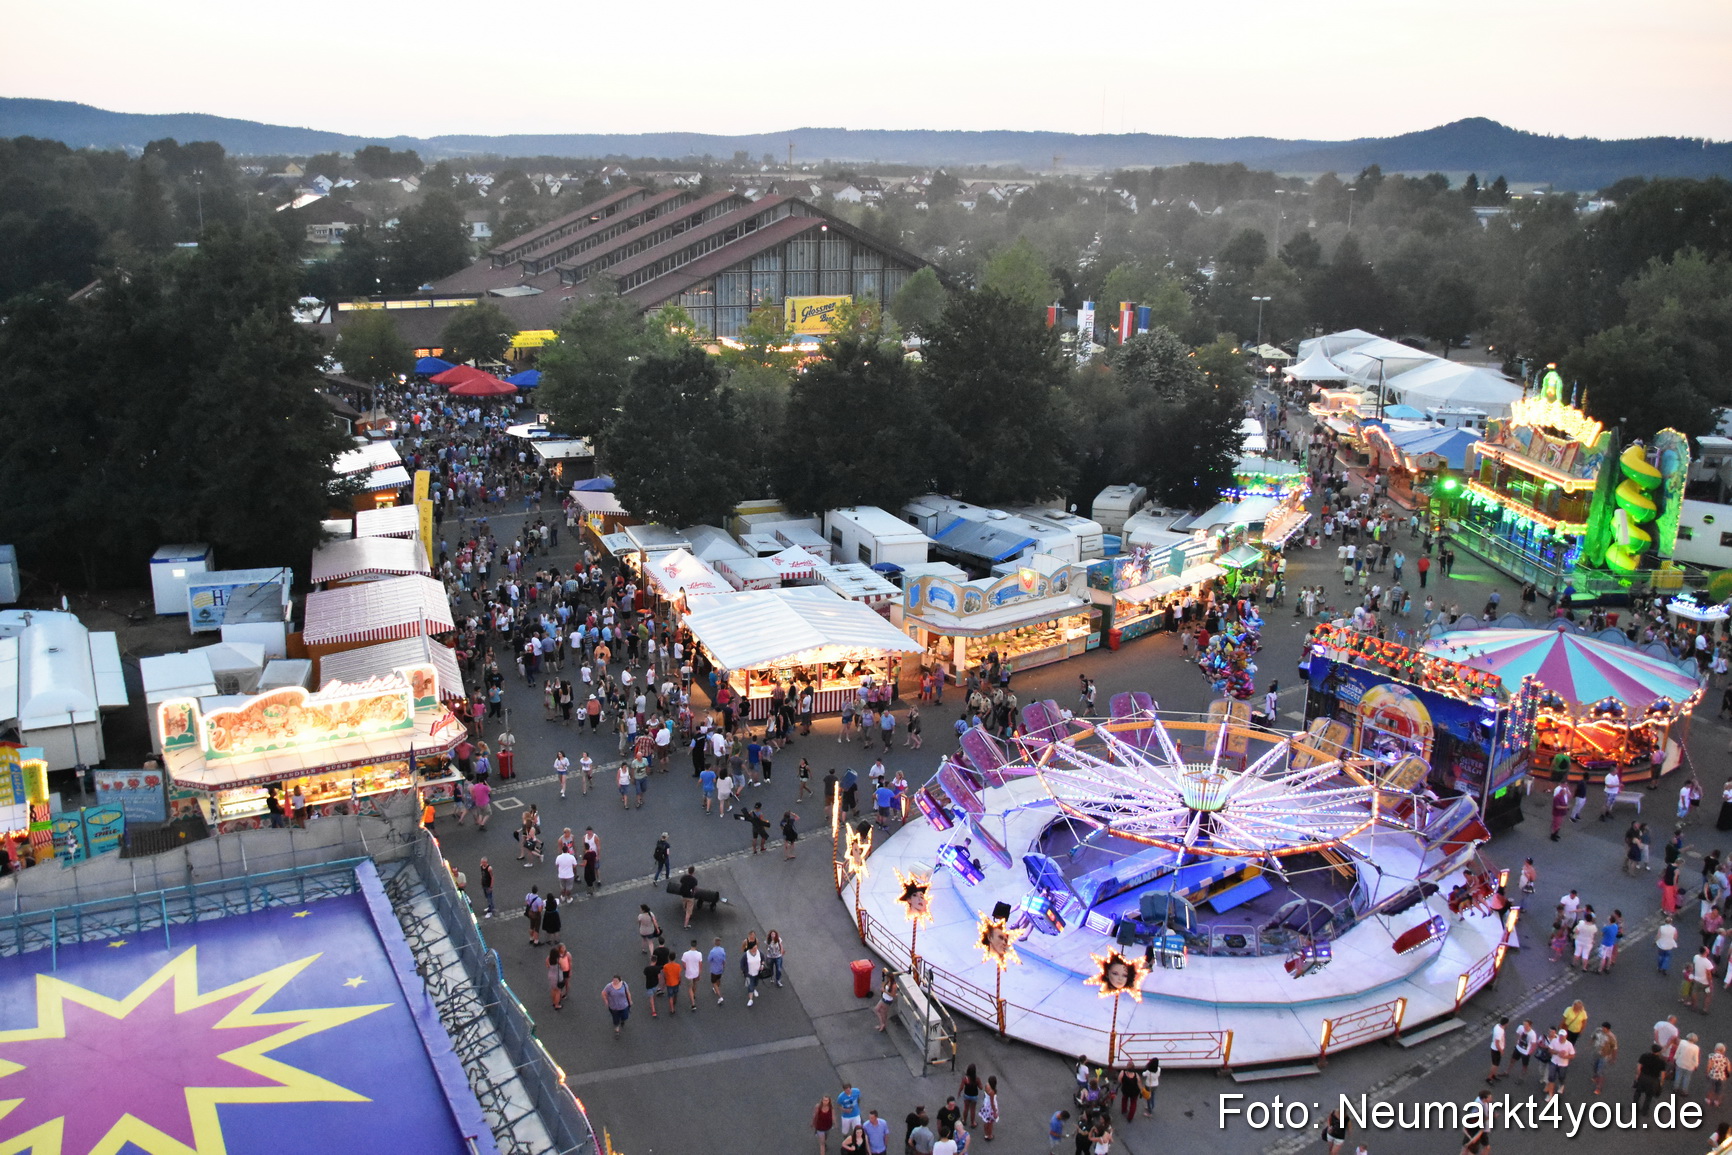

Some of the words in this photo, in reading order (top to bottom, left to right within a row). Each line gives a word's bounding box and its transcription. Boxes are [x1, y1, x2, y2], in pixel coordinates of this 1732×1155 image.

[801, 302, 837, 324] Glossner
[219, 776, 271, 789] GEBRANNTE
[276, 768, 316, 779] MANDELN
[326, 762, 353, 771] NÜSSE
[360, 753, 406, 765] LEBKUCHEN
[178, 781, 209, 790] POPCORN
